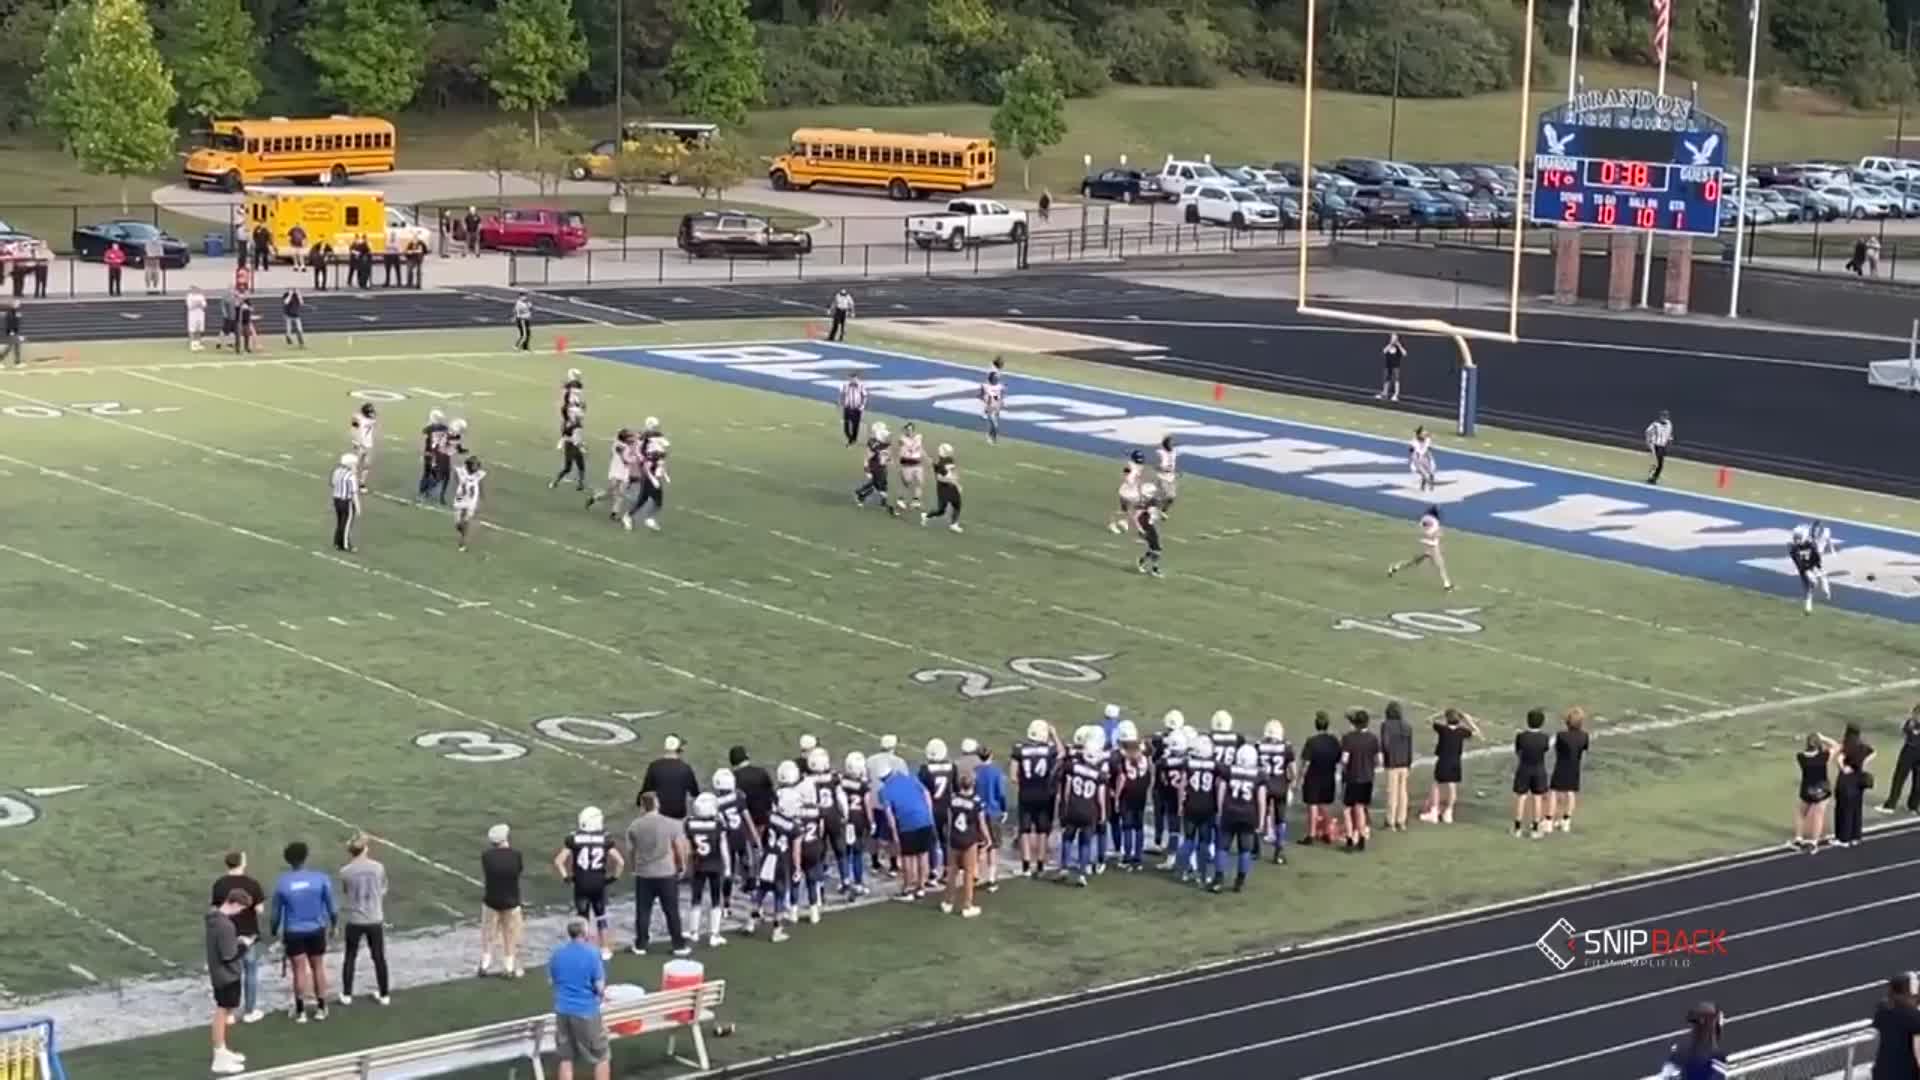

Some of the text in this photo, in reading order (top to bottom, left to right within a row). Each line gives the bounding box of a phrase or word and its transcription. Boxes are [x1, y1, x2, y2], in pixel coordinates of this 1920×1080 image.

[1574, 88, 1693, 121] BRANDON
[1564, 112, 1699, 133] HIGH SCHOOL
[1543, 170, 1561, 187] 14
[1601, 161, 1648, 187] 0:38
[1704, 180, 1717, 201] 0
[1565, 202, 1577, 221] 2
[1597, 204, 1616, 225] 10
[1637, 208, 1655, 227] 10
[1676, 212, 1684, 229] 1
[1331, 611, 1485, 640] 10
[912, 656, 1107, 699] 20
[414, 714, 640, 763] 30
[1214, 746, 1236, 766] 76
[1259, 754, 1285, 775] 52
[1023, 758, 1048, 779] 14
[934, 776, 948, 799] 7
[1189, 770, 1214, 792] 49
[1229, 780, 1254, 801] 75
[954, 812, 968, 832] 4
[693, 834, 711, 856] 5
[576, 846, 605, 871] 42
